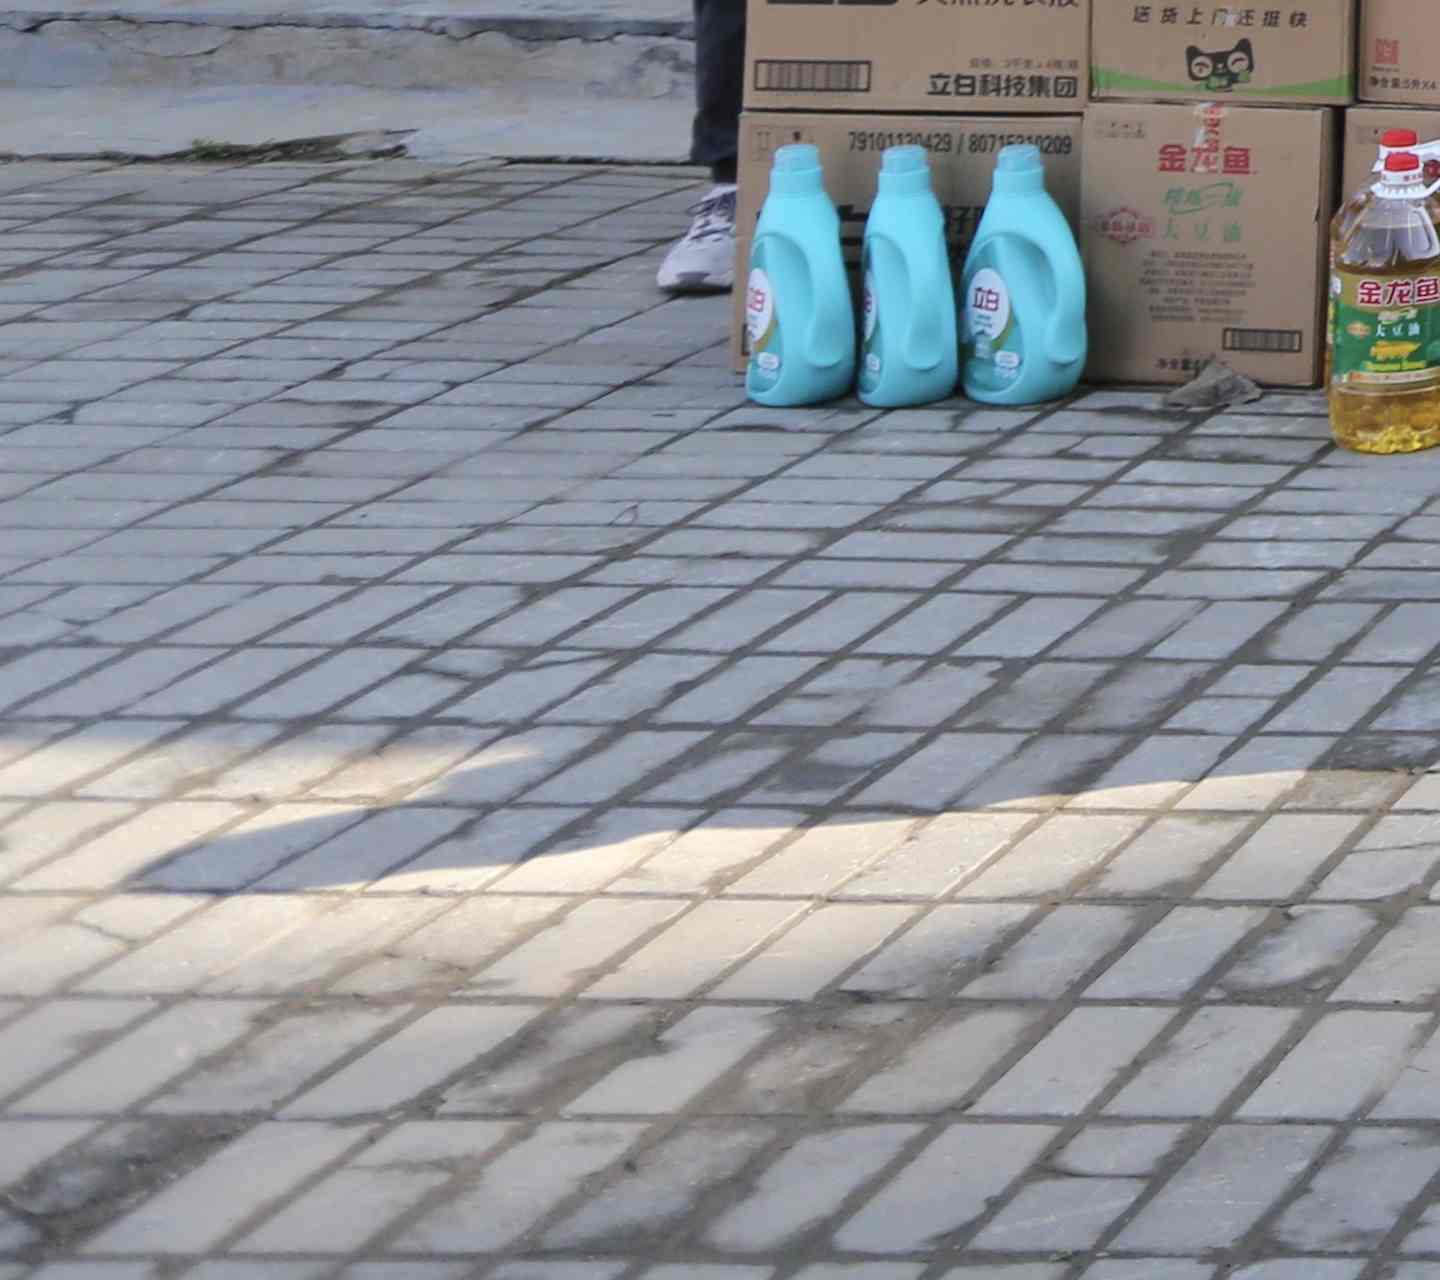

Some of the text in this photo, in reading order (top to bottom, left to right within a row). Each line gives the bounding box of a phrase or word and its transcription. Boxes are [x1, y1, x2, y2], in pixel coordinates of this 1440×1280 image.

[1132, 5, 1308, 28] 送货上门还挺快
[928, 73, 1077, 98] 立白科技集团
[1157, 144, 1252, 175] 金龙鱼
[973, 287, 1000, 310] 立白
